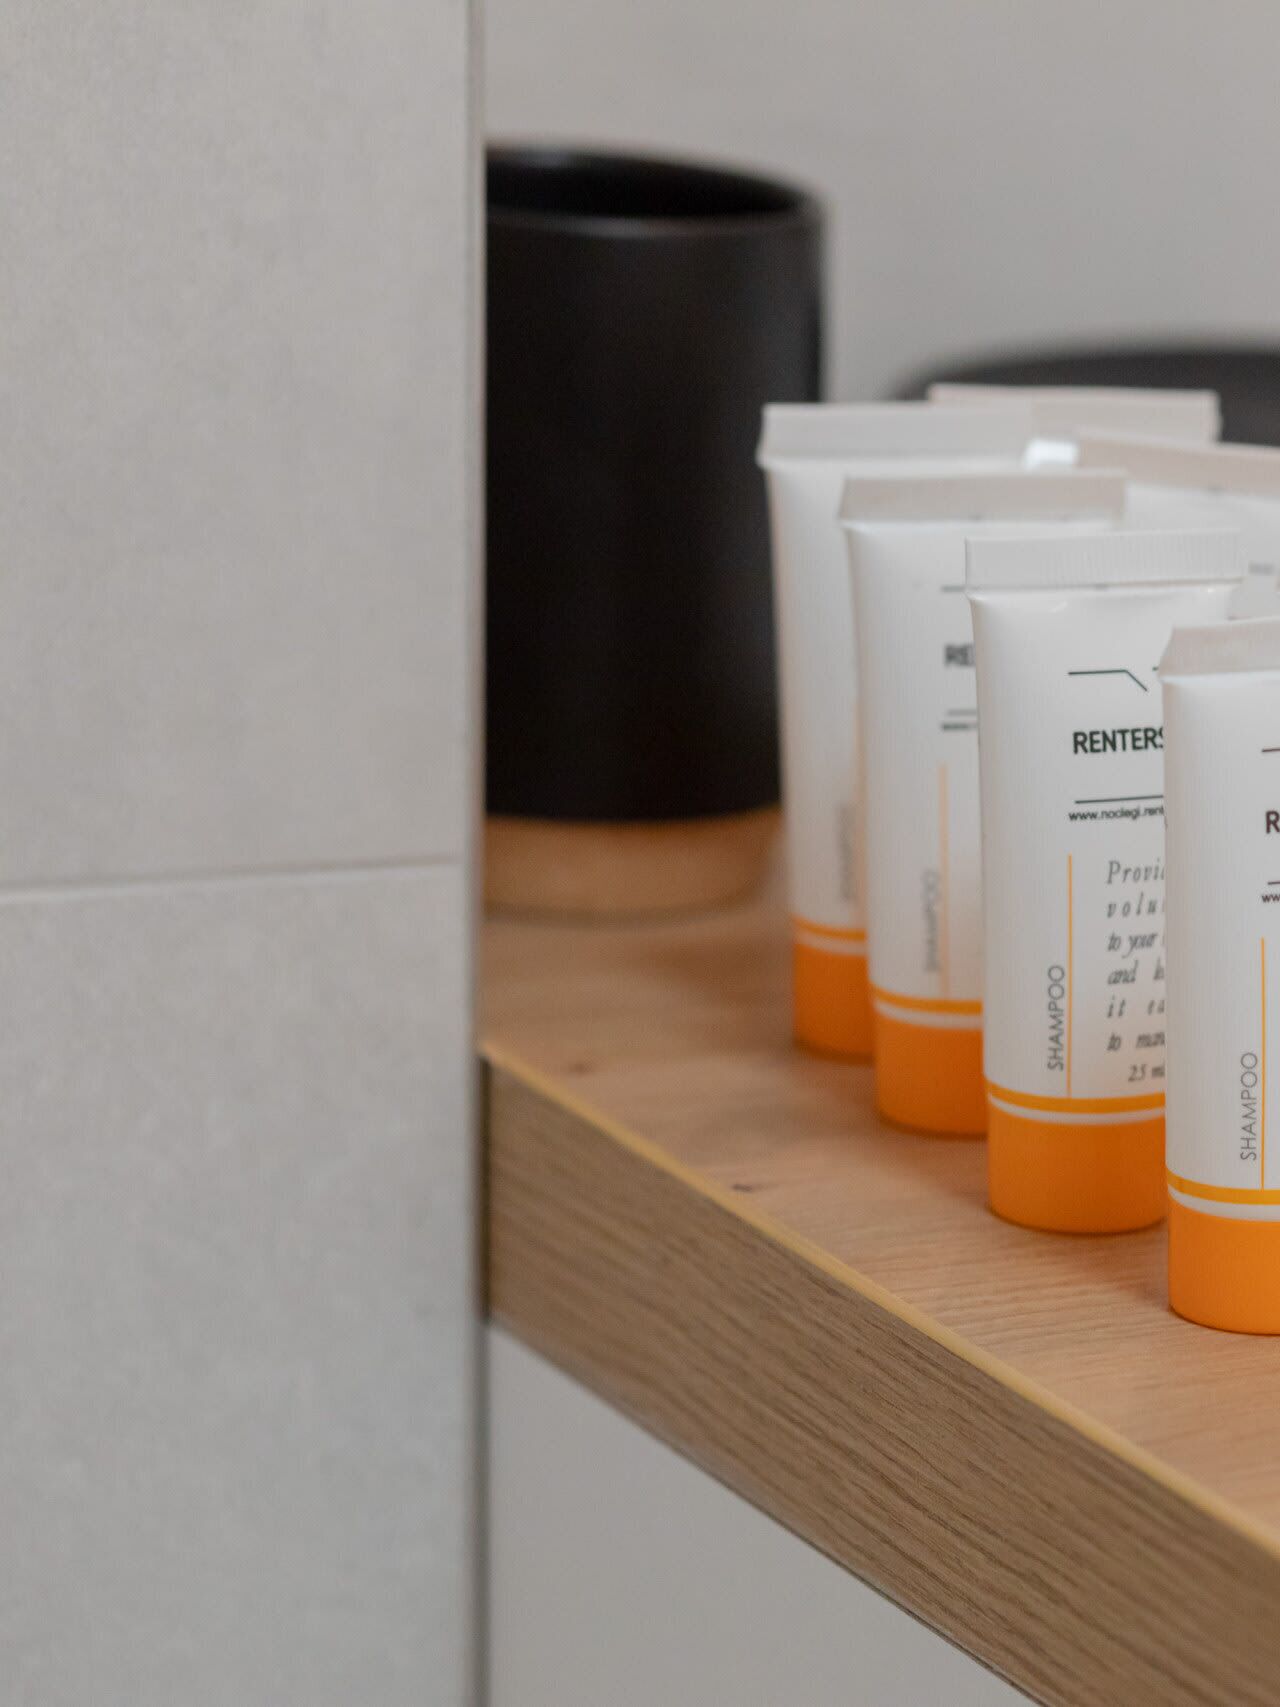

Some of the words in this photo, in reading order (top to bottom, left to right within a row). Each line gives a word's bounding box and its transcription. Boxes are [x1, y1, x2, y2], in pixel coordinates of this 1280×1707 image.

[1106, 891, 1165, 919] volu
[1107, 931, 1121, 952] to
[1107, 959, 1139, 985] and
[1048, 965, 1065, 1071] SHAMPOO
[1107, 995, 1127, 1019] it
[1240, 1052, 1258, 1161] SHAMPOO
